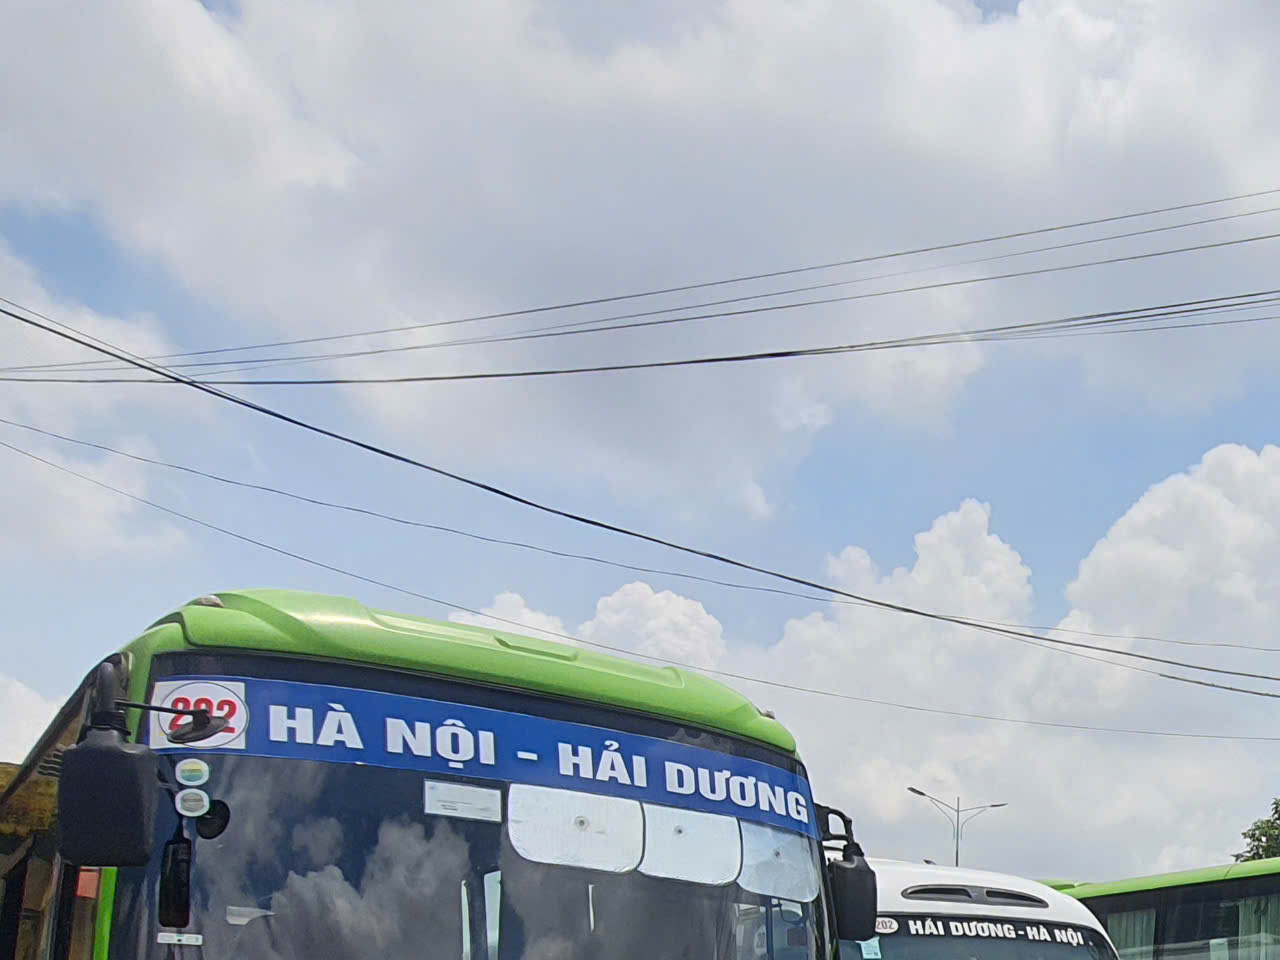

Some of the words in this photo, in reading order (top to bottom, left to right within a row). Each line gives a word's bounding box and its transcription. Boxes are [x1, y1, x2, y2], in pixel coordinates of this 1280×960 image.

[268, 702, 365, 750] HÀ
[385, 718, 495, 769] NỘI
[517, 751, 538, 760] -
[556, 740, 648, 788] HẢI
[664, 760, 809, 824] DƯƠNG
[949, 920, 1017, 939] DƯƠNG
[1026, 924, 1051, 942] HÀ
[1053, 927, 1085, 946] NỘI
